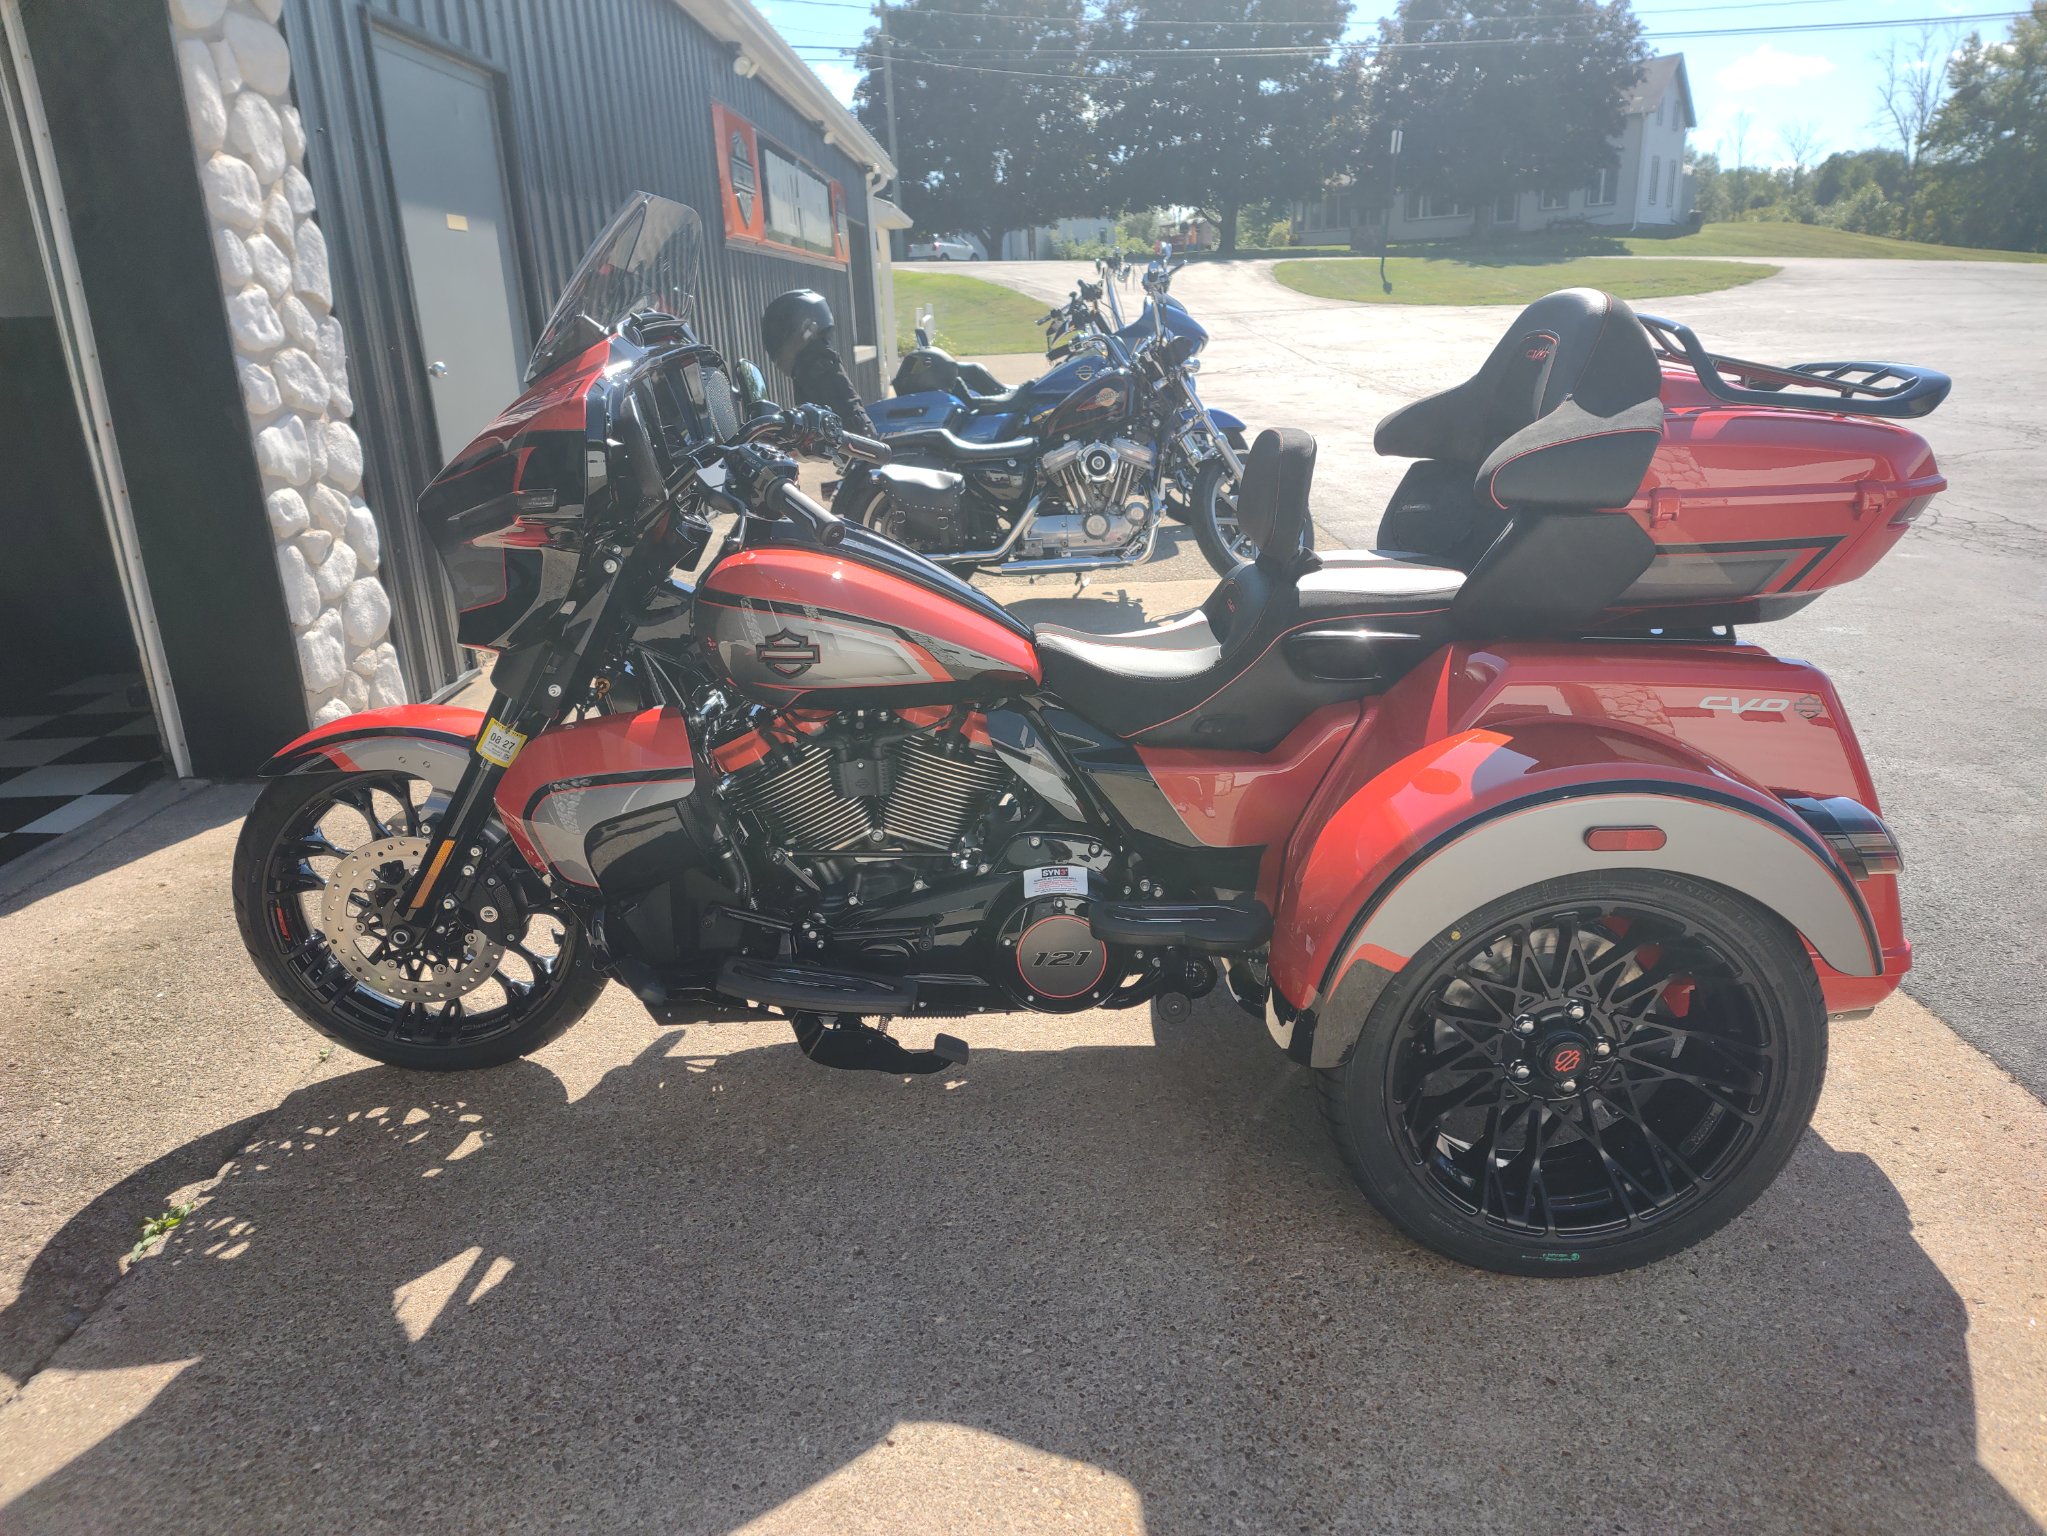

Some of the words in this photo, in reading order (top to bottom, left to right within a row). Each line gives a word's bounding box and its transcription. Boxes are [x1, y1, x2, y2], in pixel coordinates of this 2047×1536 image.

[1698, 696, 1790, 713] CVO
[490, 732, 502, 744] 08
[502, 739, 516, 751] 27
[1042, 868, 1068, 877] SYN3
[1032, 950, 1092, 968] 121
